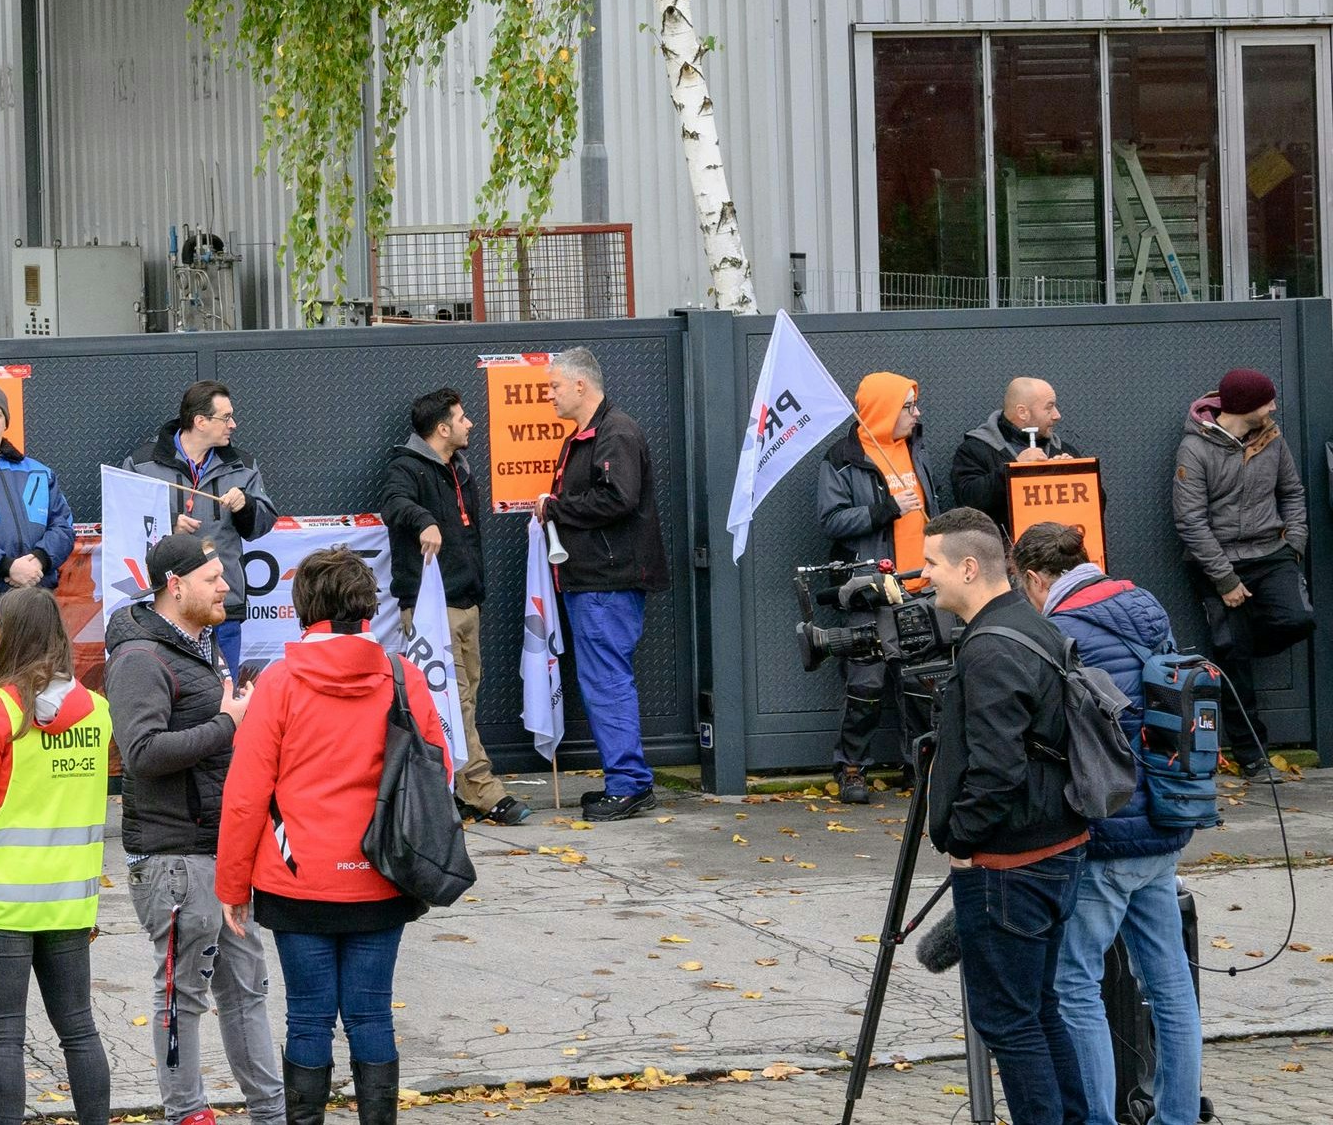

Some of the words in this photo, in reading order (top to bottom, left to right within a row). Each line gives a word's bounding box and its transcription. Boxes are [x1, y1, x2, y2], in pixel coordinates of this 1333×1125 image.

[504, 383, 551, 405] HIE
[508, 422, 565, 442] WIRD
[1023, 482, 1090, 506] HIER
[41, 726, 101, 750] ORDNER
[52, 757, 96, 772] PRO-GE
[336, 862, 371, 870] PRO-GE
